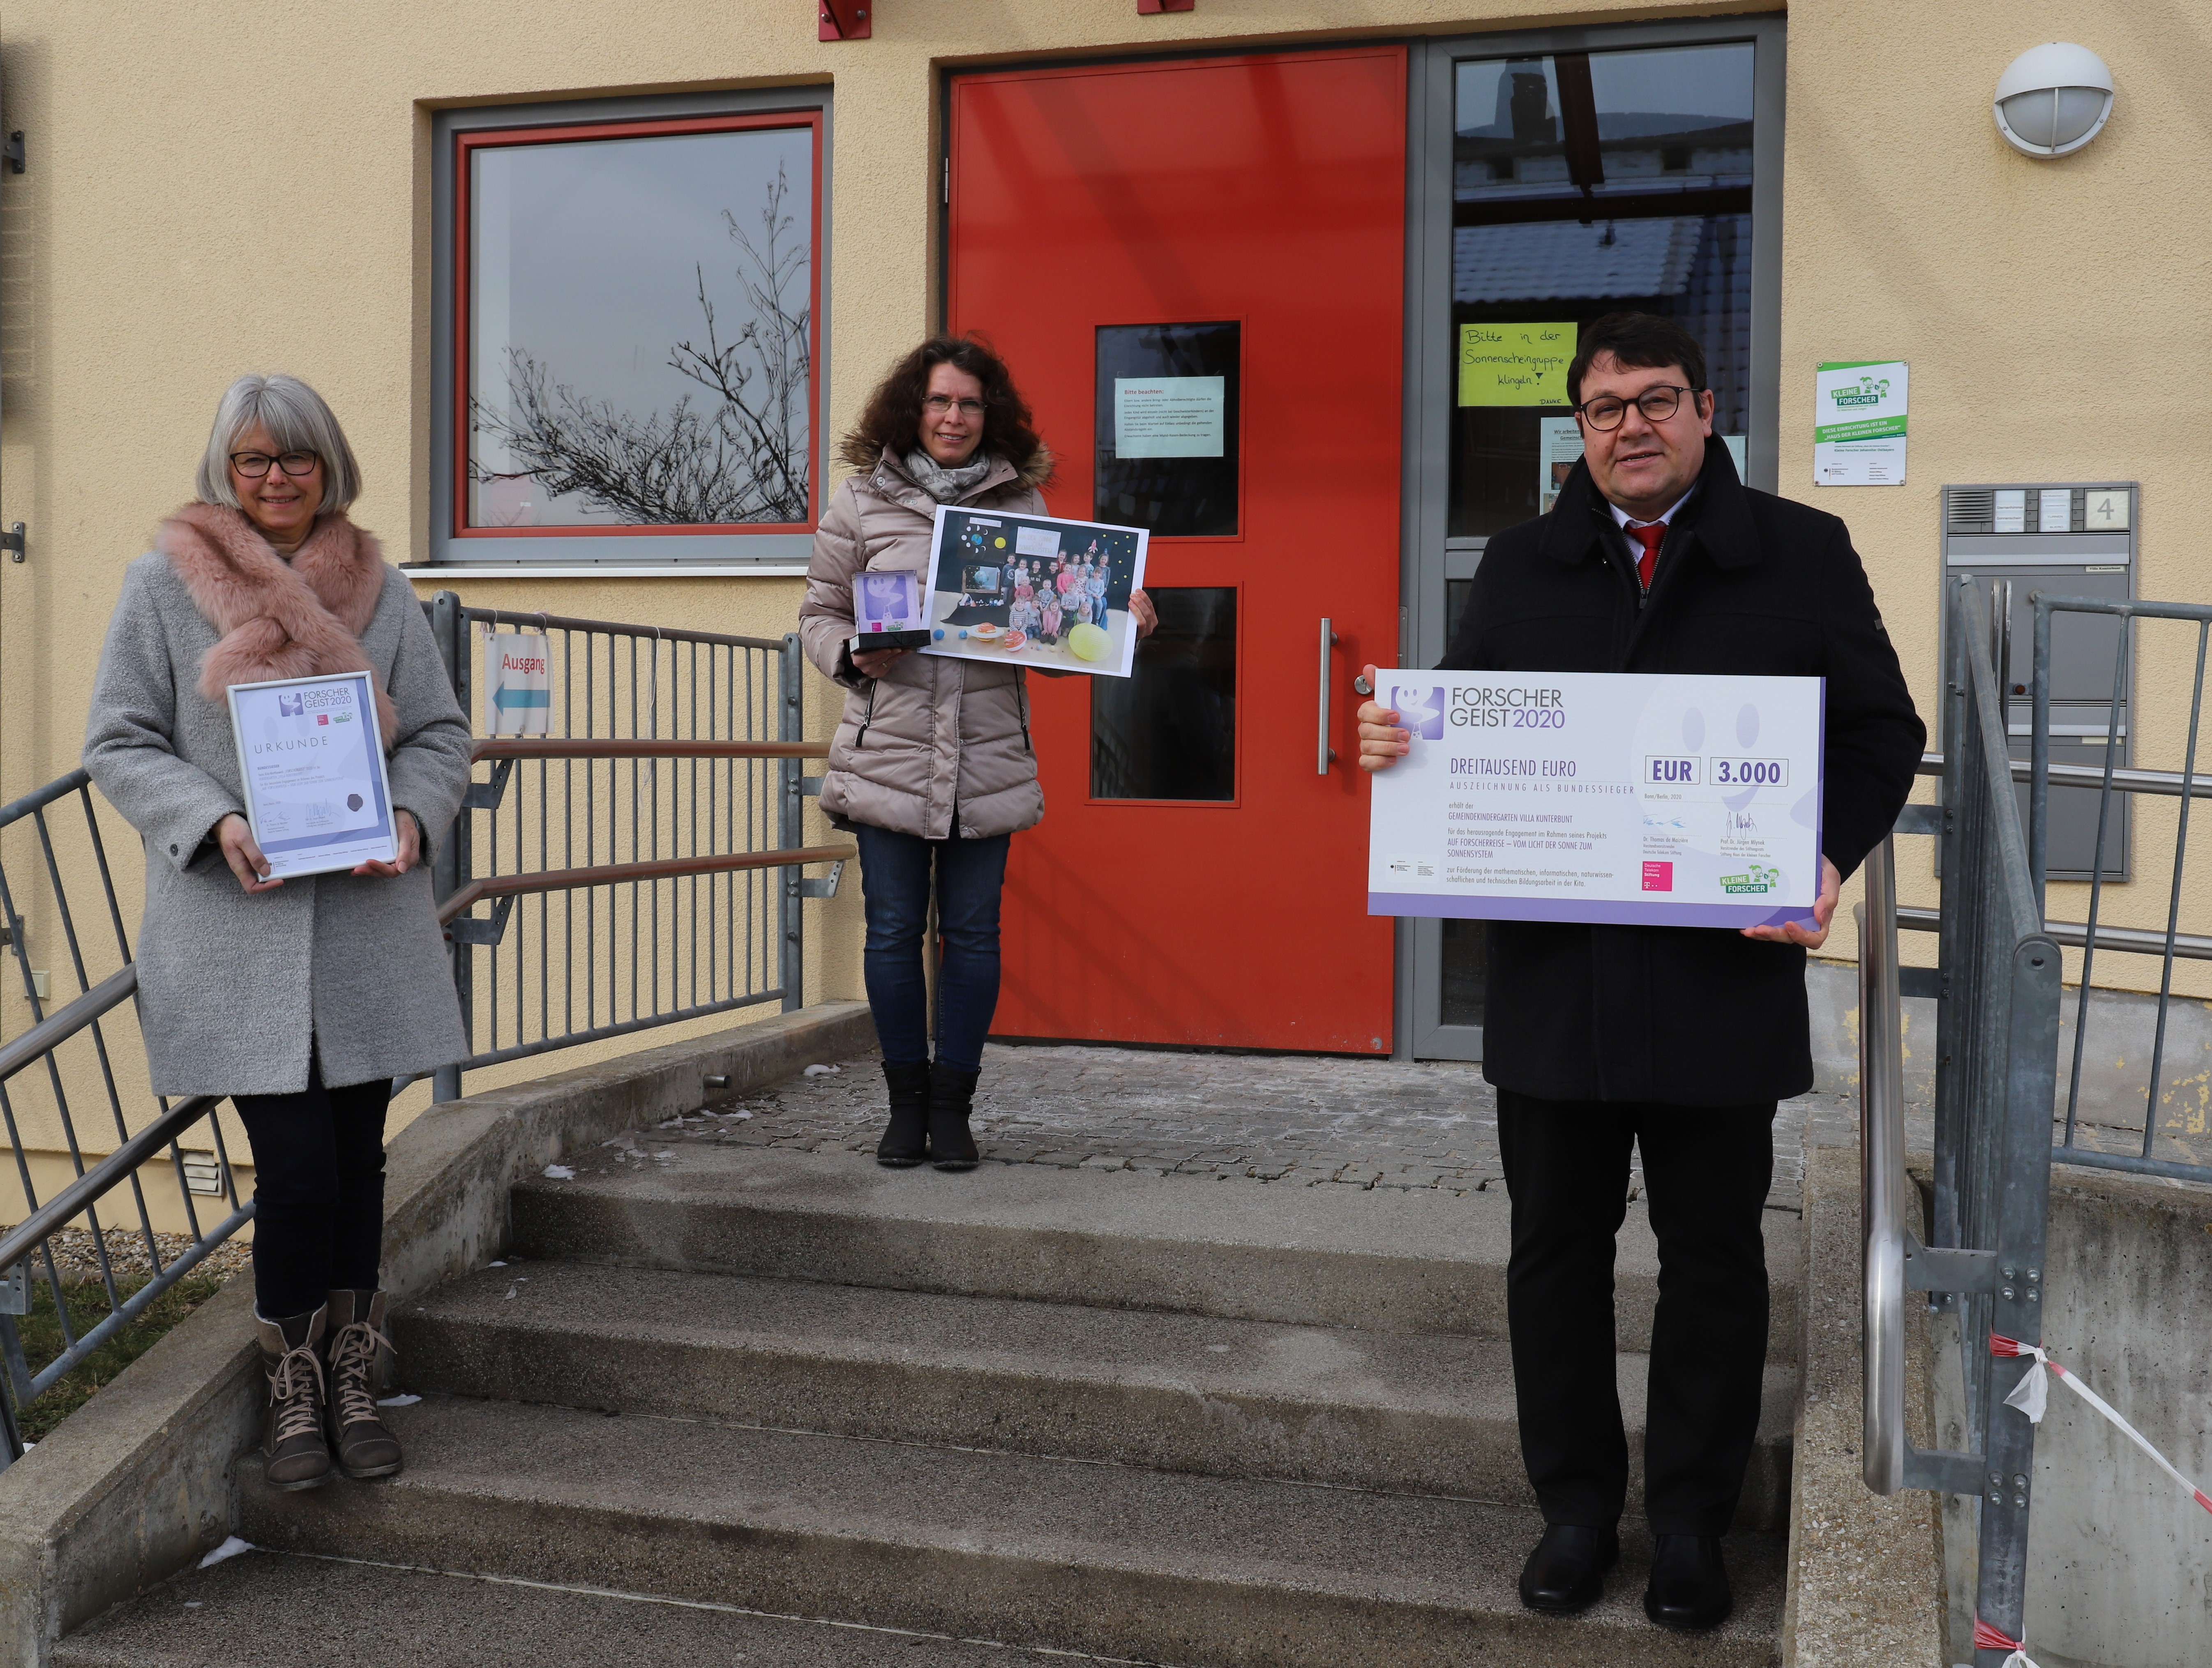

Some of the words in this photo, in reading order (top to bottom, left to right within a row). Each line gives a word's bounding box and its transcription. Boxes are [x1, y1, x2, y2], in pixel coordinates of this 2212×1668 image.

[1465, 330, 1502, 344] Bitte
[1520, 334, 1532, 344] in
[1540, 330, 1561, 340] der
[1463, 349, 1564, 371] Sonnenscheingruppe
[1833, 388, 1858, 397] KLEINE
[1839, 396, 1876, 404] FORSCHER
[1837, 423, 1869, 431] EINRICHTUNG
[2097, 498, 2114, 520] 4
[502, 653, 544, 675] Ausgang
[304, 687, 350, 700] FORSCHER
[1452, 687, 1564, 708] FORSCHER
[254, 736, 328, 754] URKUNDE
[1451, 758, 1536, 775] DREITAUSEND
[1543, 760, 1576, 776] EURO
[1653, 760, 1692, 781] EUR
[1718, 761, 1780, 783] 3.000
[1450, 782, 1527, 791] AUSZEICHNUNG
[1557, 784, 1634, 794] BUNDESSIEGER
[1449, 812, 1518, 821] GEMEINDEKINDERGARTEN
[1536, 815, 1573, 823] KUNTERBUNT
[1467, 828, 1504, 837] herausragende
[1506, 829, 1536, 838] Engagement
[1460, 838, 1504, 847] FORSCHERREISE
[1447, 849, 1493, 858] SONNENSYSTEM
[1457, 866, 1482, 875] Förderung
[1494, 868, 1537, 876] mathematischen,
[1539, 869, 1579, 878] informatischen,
[1519, 878, 1555, 887] Bildungsarbeit
[1722, 875, 1747, 885] KLEINE
